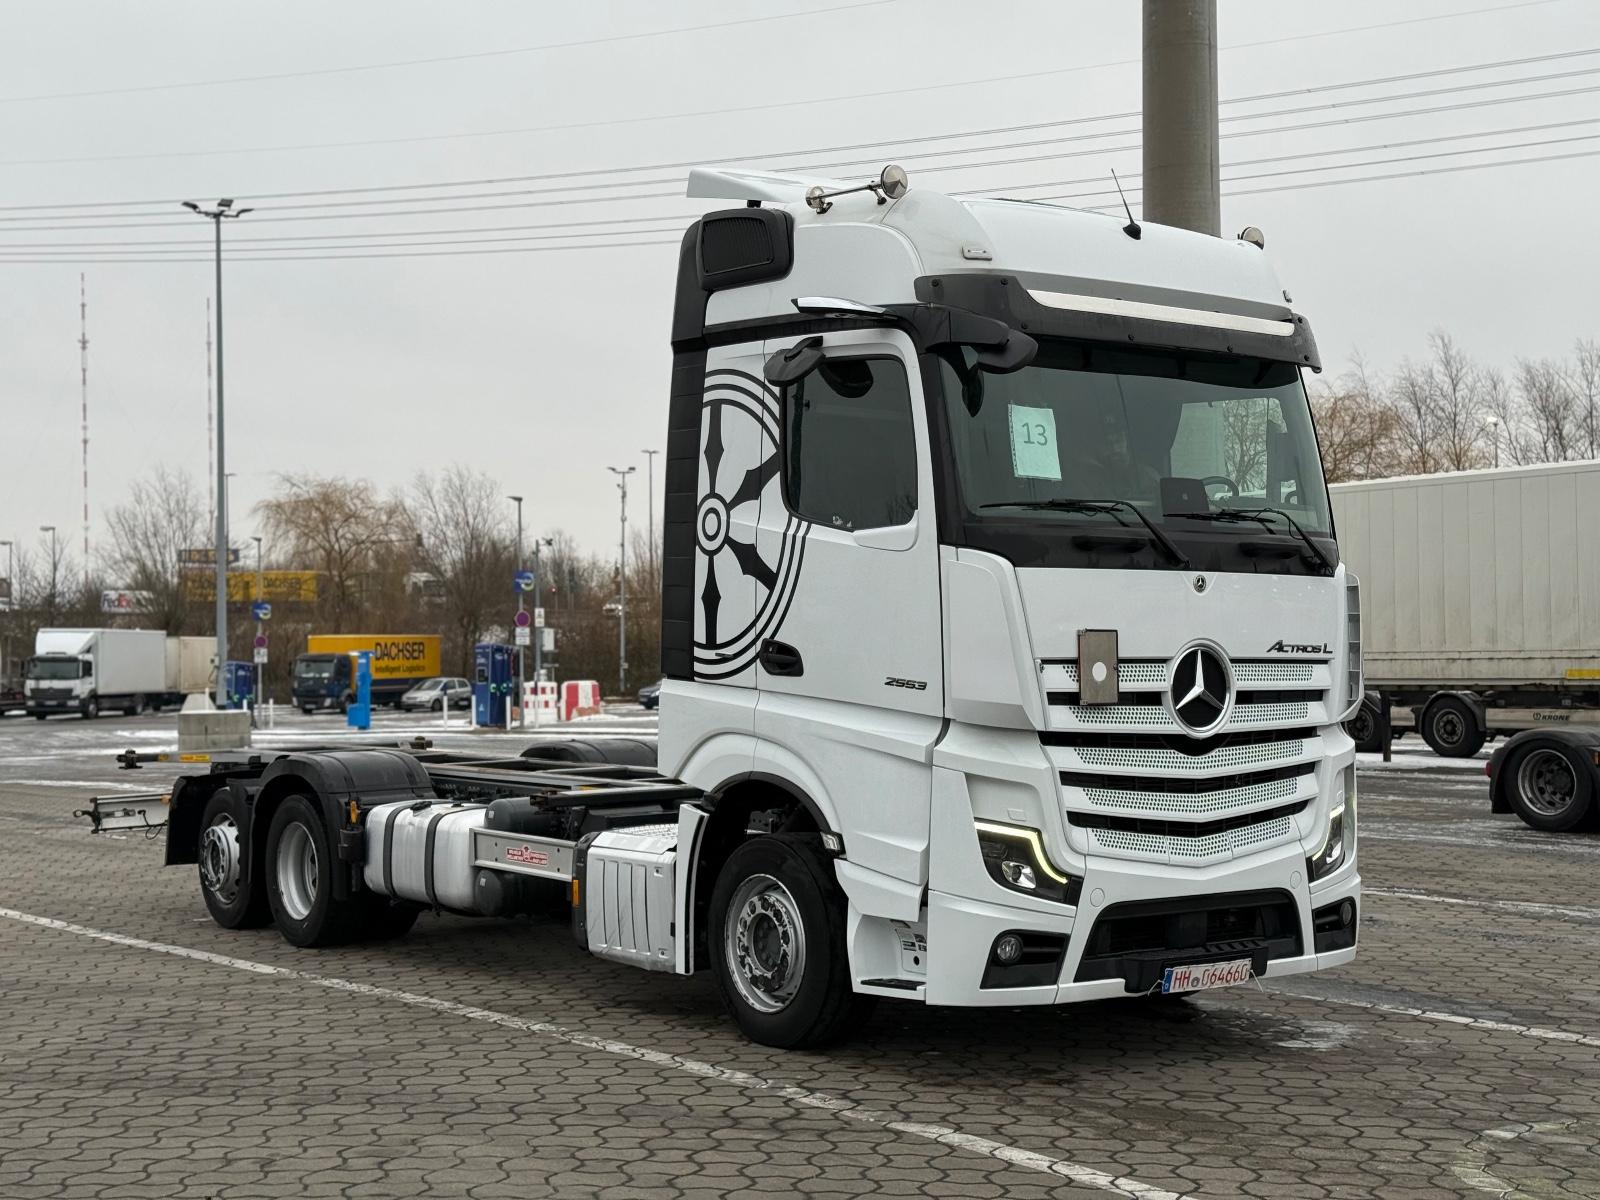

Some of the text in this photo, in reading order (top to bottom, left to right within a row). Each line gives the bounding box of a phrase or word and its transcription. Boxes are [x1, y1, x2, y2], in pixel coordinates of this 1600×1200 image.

[1022, 422, 1048, 446] 13
[375, 641, 426, 660] DACHSER
[1323, 642, 1333, 654] L
[884, 676, 928, 691] 2553
[1172, 969, 1192, 989] HH
